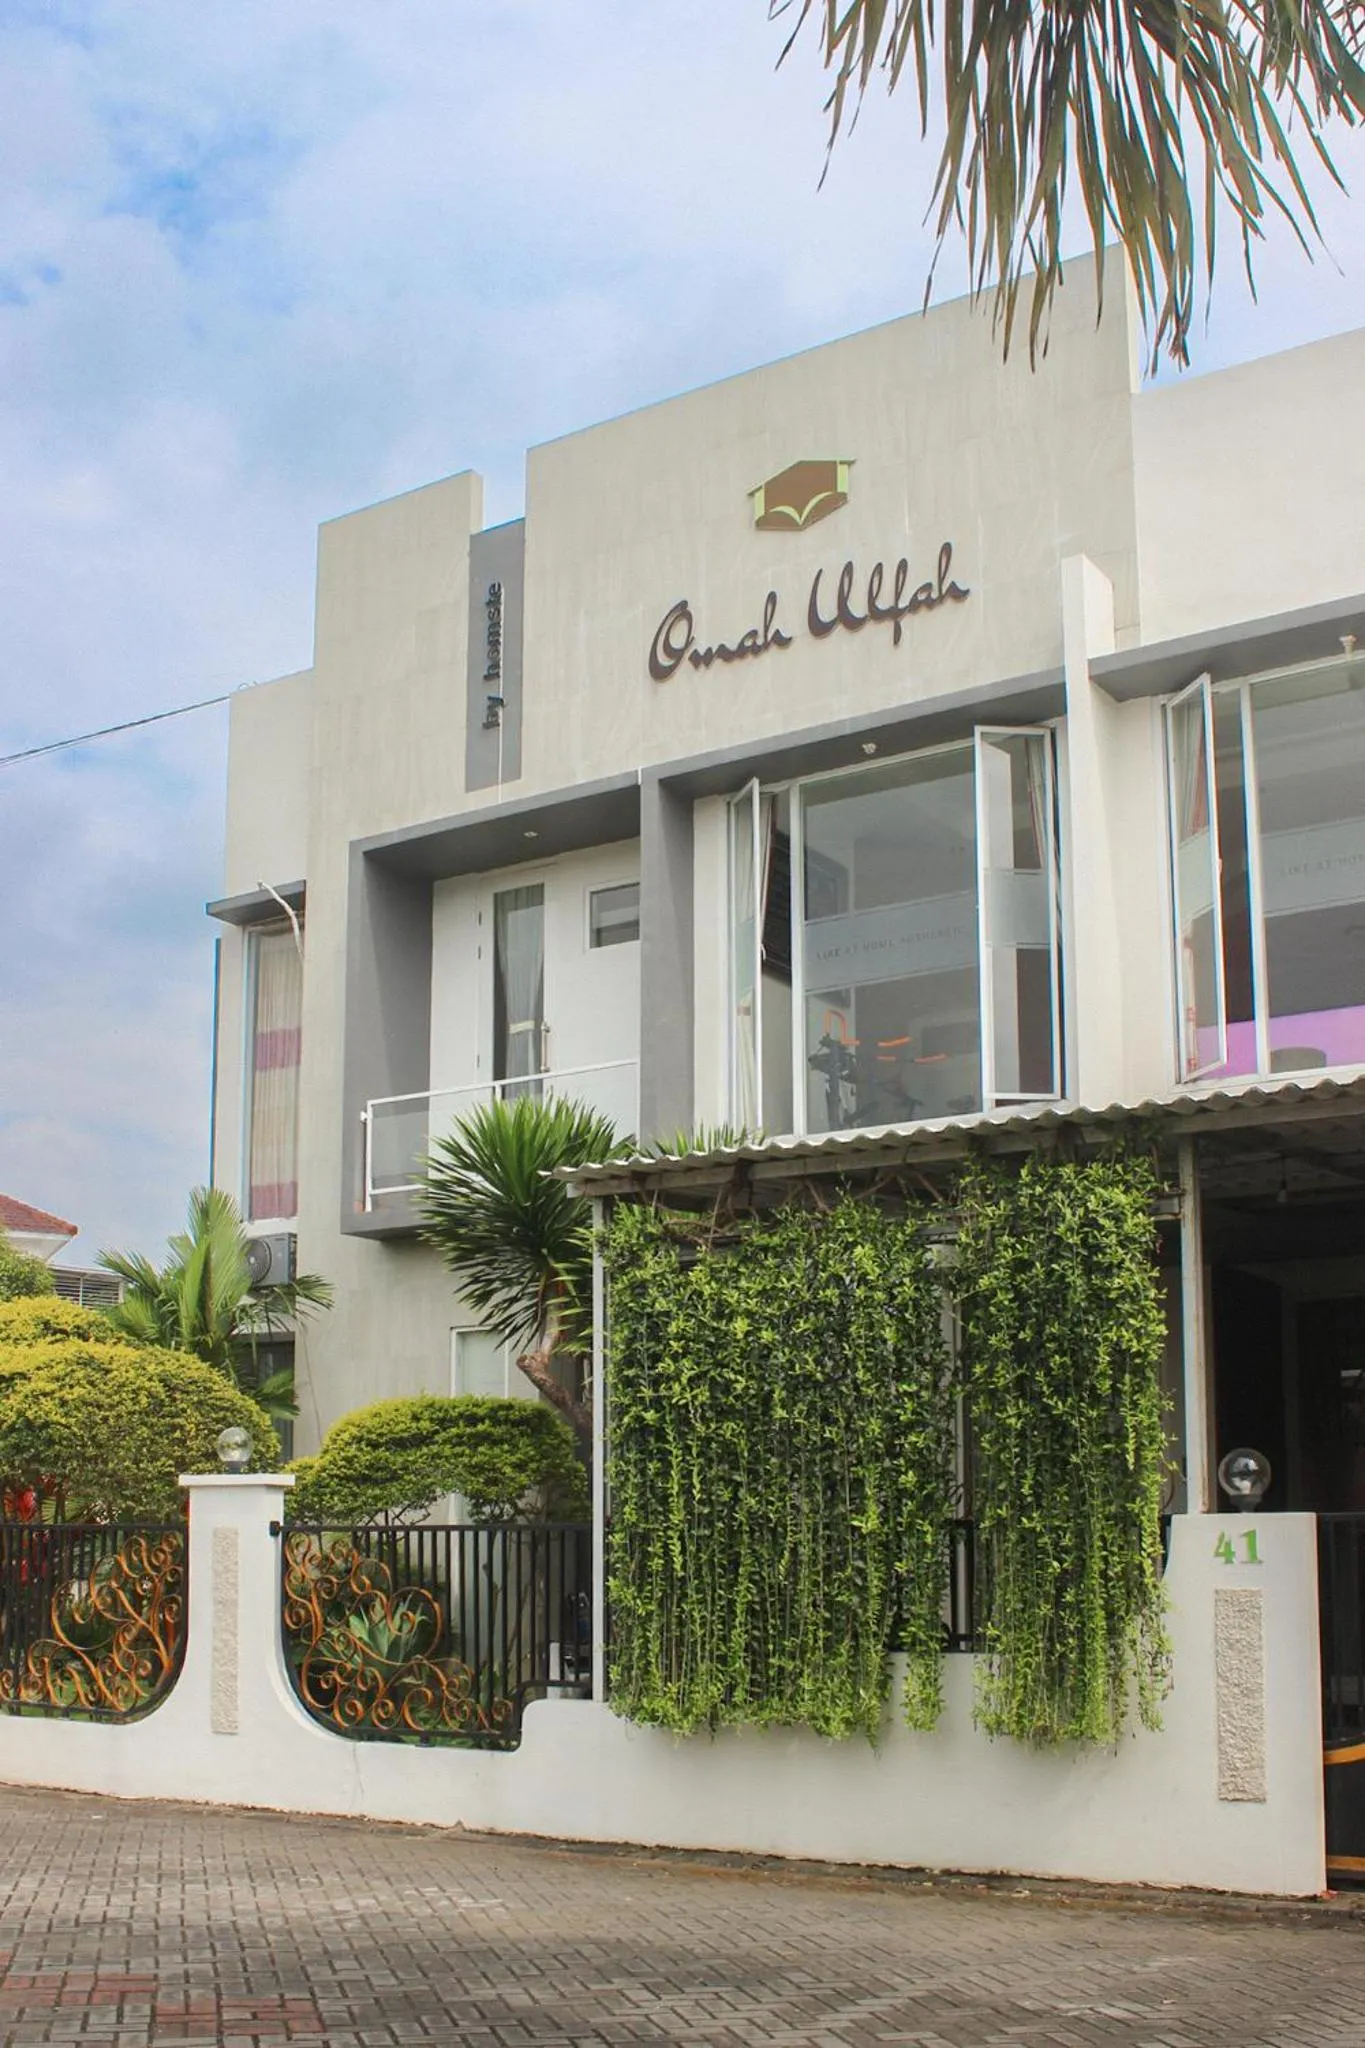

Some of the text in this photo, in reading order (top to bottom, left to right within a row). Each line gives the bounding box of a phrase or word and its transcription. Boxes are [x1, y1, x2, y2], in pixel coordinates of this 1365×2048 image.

[648, 541, 971, 682] Omah Ulfah
[482, 695, 507, 730] by
[1214, 1529, 1263, 1564] 41
